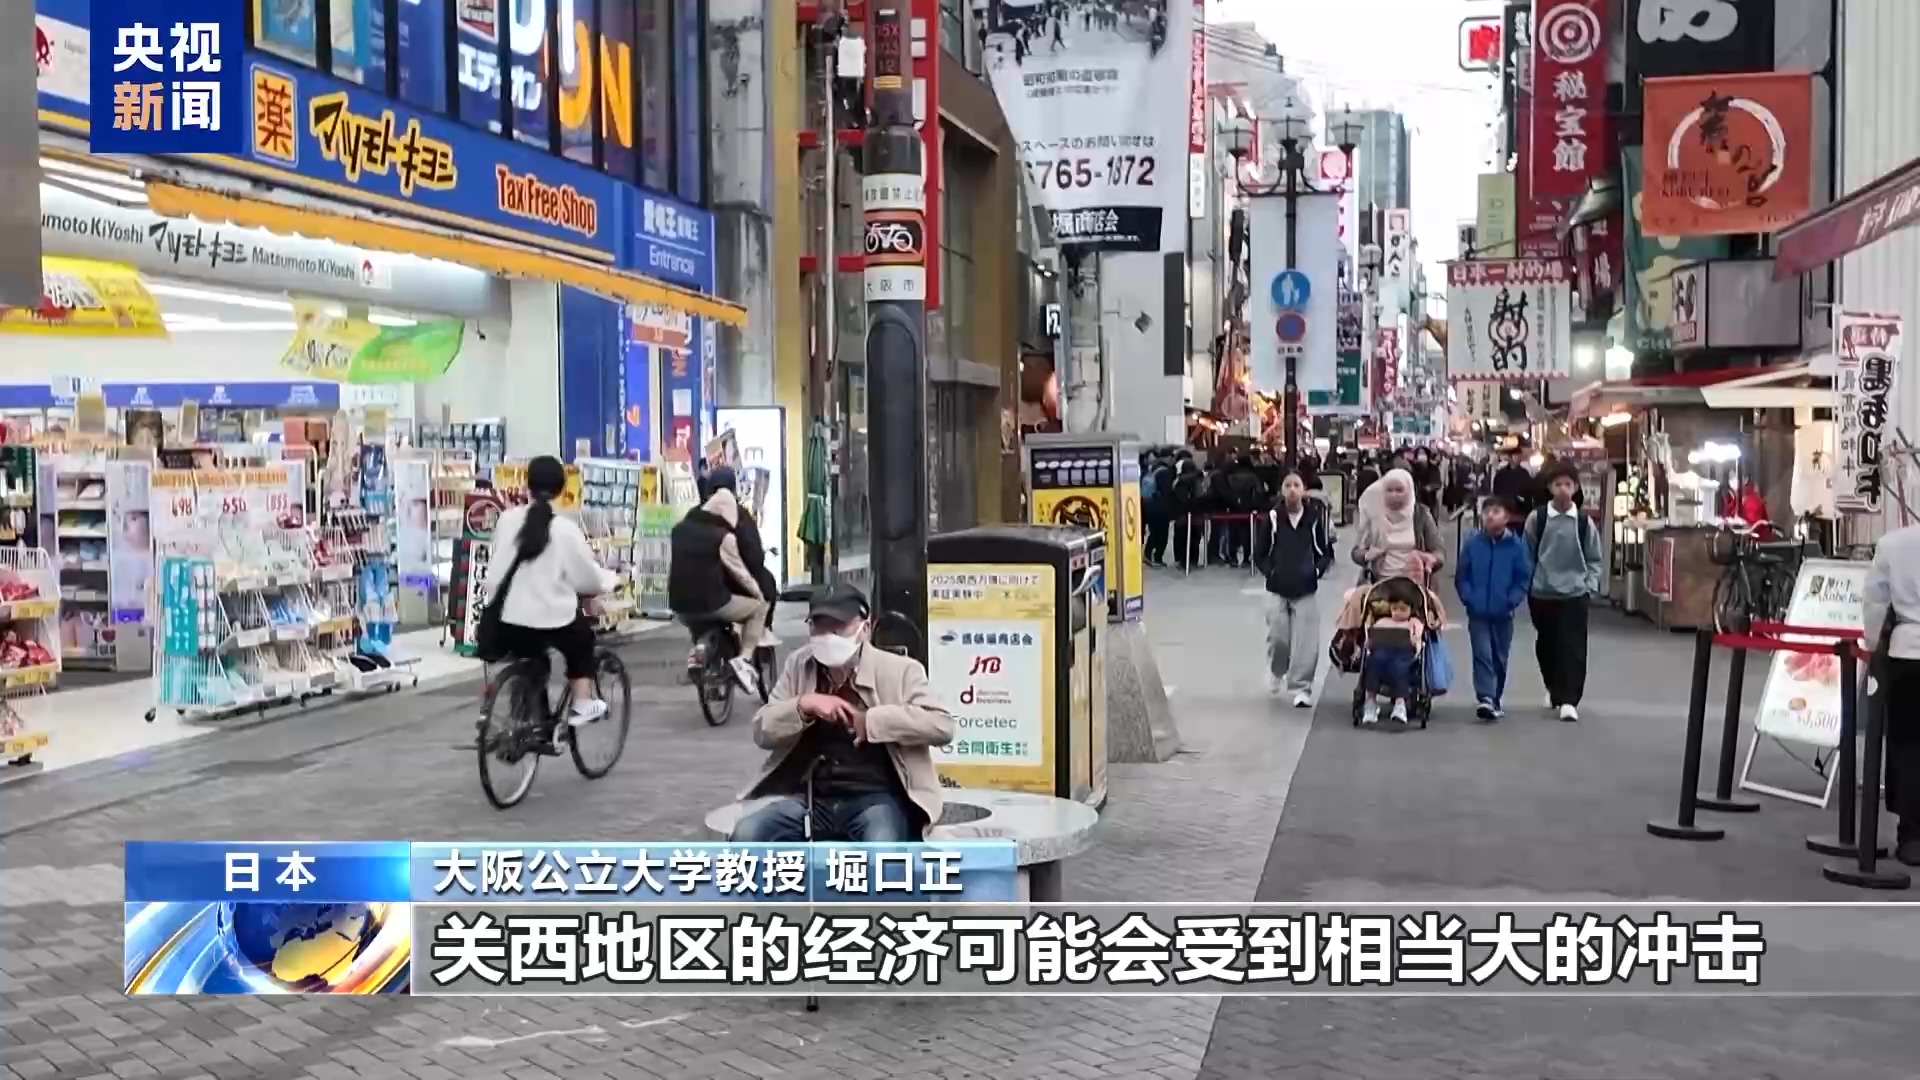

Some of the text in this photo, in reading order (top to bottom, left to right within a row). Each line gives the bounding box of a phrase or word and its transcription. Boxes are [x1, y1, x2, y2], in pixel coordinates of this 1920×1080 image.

[256, 78, 293, 155] 薬
[312, 98, 456, 192] マツモトキヨシ
[496, 164, 526, 215] Tax
[525, 174, 560, 225] Free
[560, 185, 597, 238] Shop
[91, 217, 143, 244] KiYoshi
[149, 221, 247, 268] マツモトキヨシ
[252, 246, 355, 281] Matsumoto KiYoshi
[650, 244, 695, 277] Entrance
[969, 656, 1001, 675] JTB
